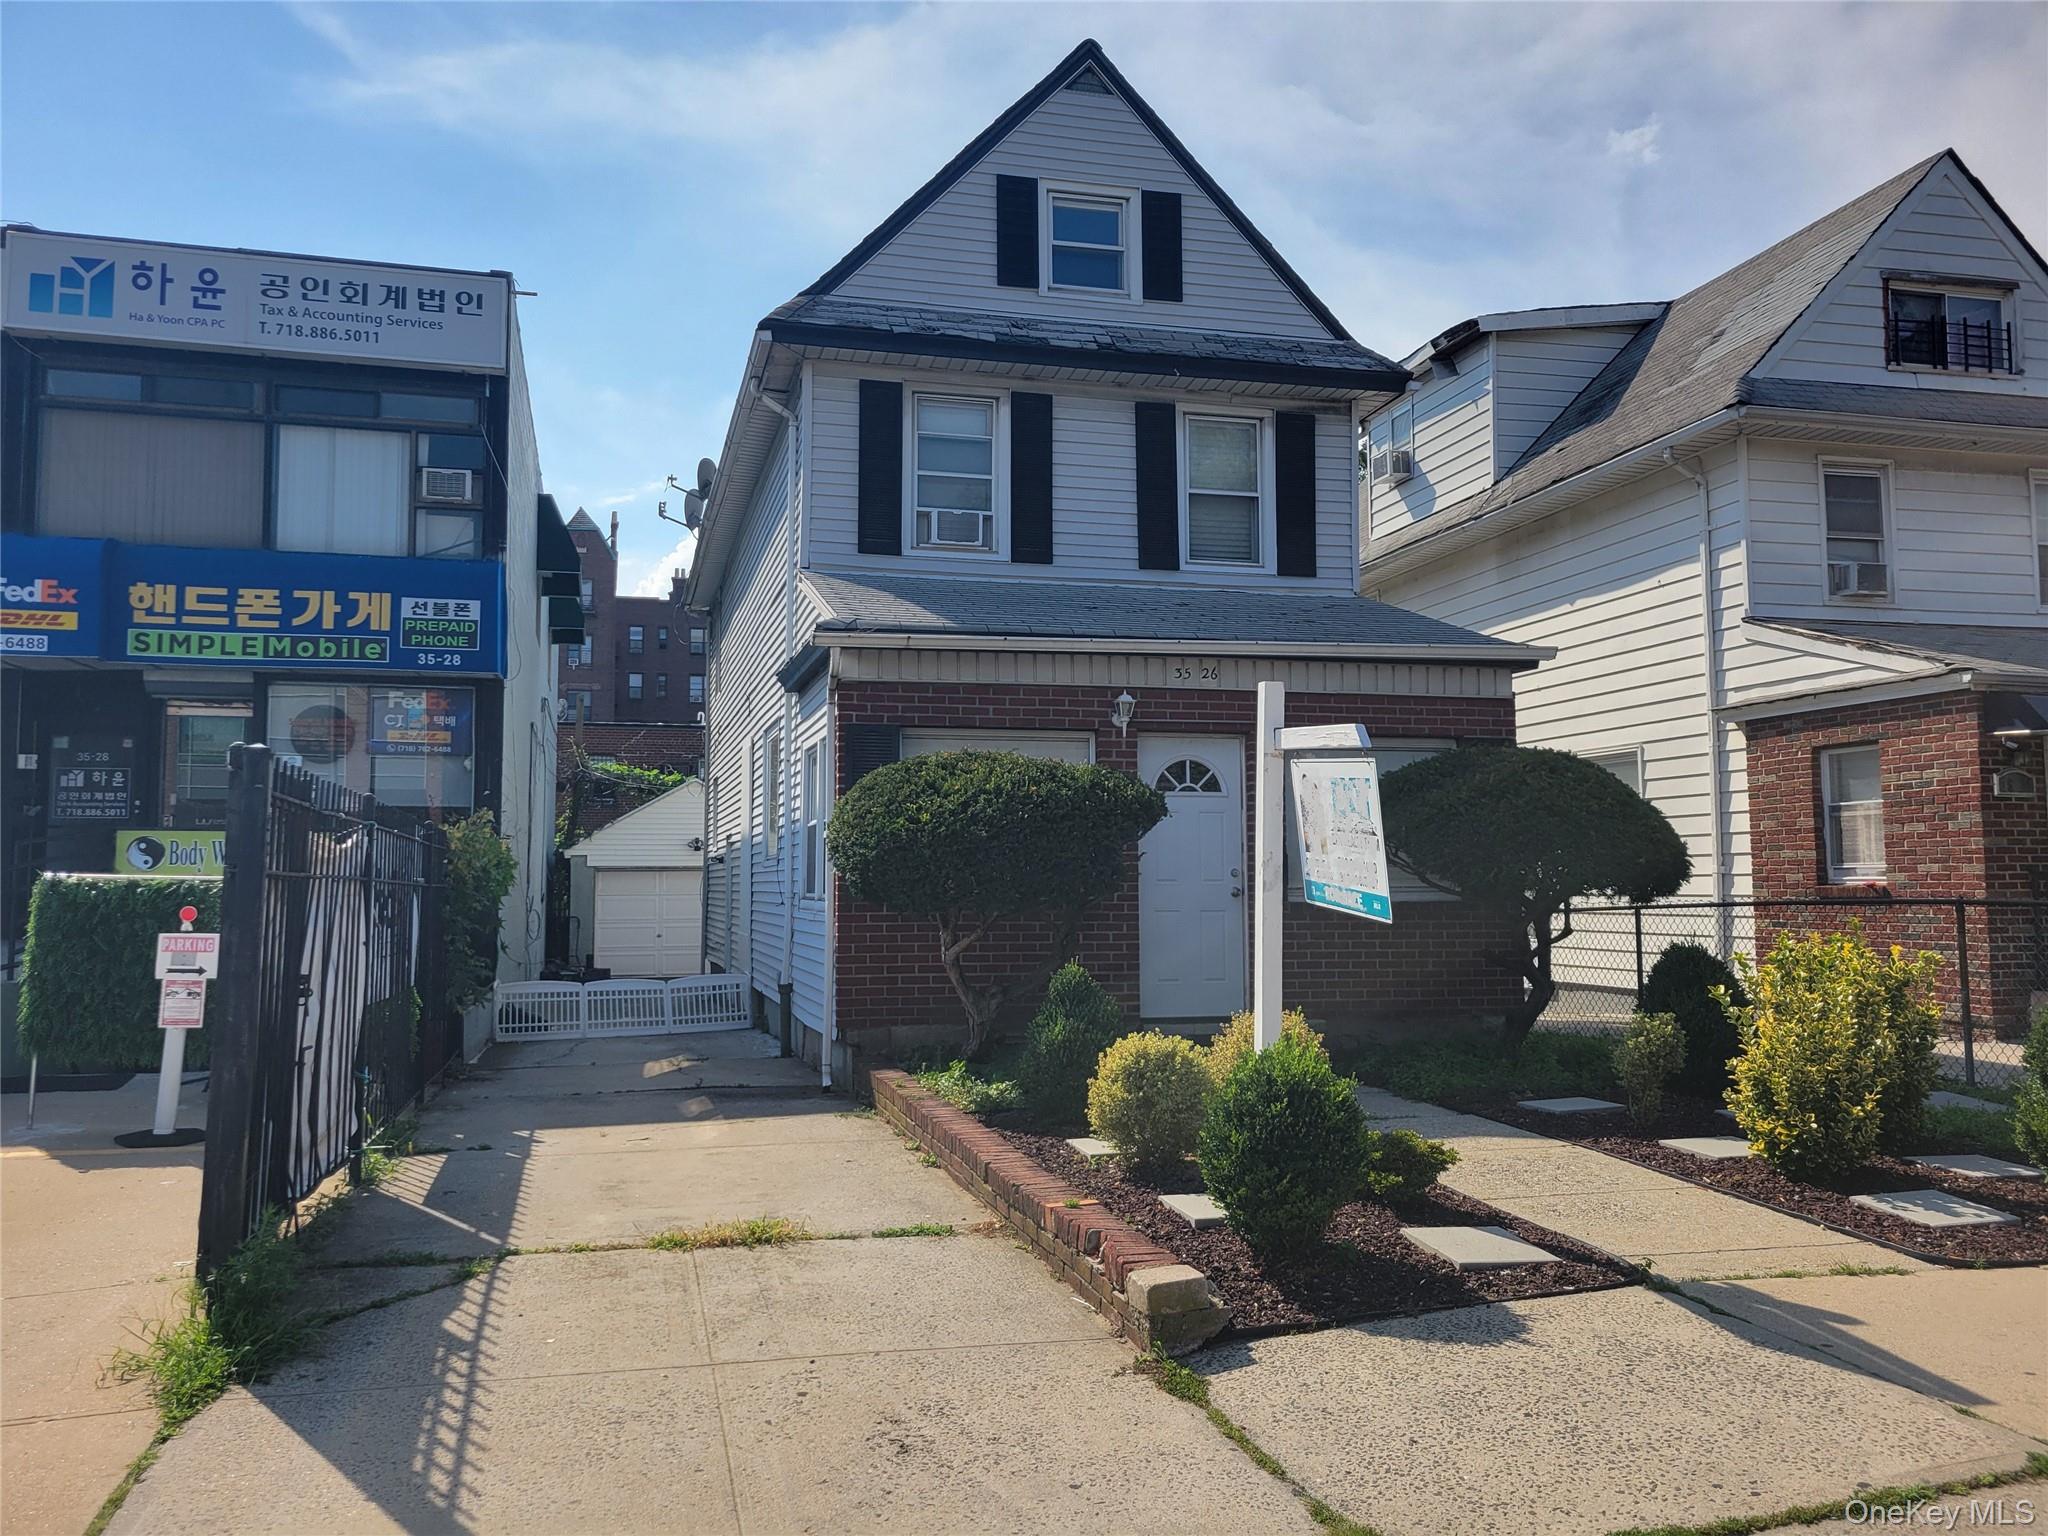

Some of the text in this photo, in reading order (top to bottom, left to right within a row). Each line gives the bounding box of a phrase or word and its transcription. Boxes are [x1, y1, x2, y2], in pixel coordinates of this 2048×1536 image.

[259, 273, 484, 317] 공인회계법인
[129, 312, 226, 329] Ha & Yoon CPA PC
[259, 304, 444, 331] Tax & Accounting Services
[259, 321, 380, 343] T. 718.886.5011
[411, 601, 471, 618] 선불폰
[0, 612, 66, 627] DHL
[405, 620, 476, 632] PREPAID
[411, 635, 469, 647] PHONE
[417, 653, 462, 666] 35-28
[77, 752, 109, 761] 35-28
[169, 840, 207, 872] Body
[161, 938, 215, 952] PARKING
